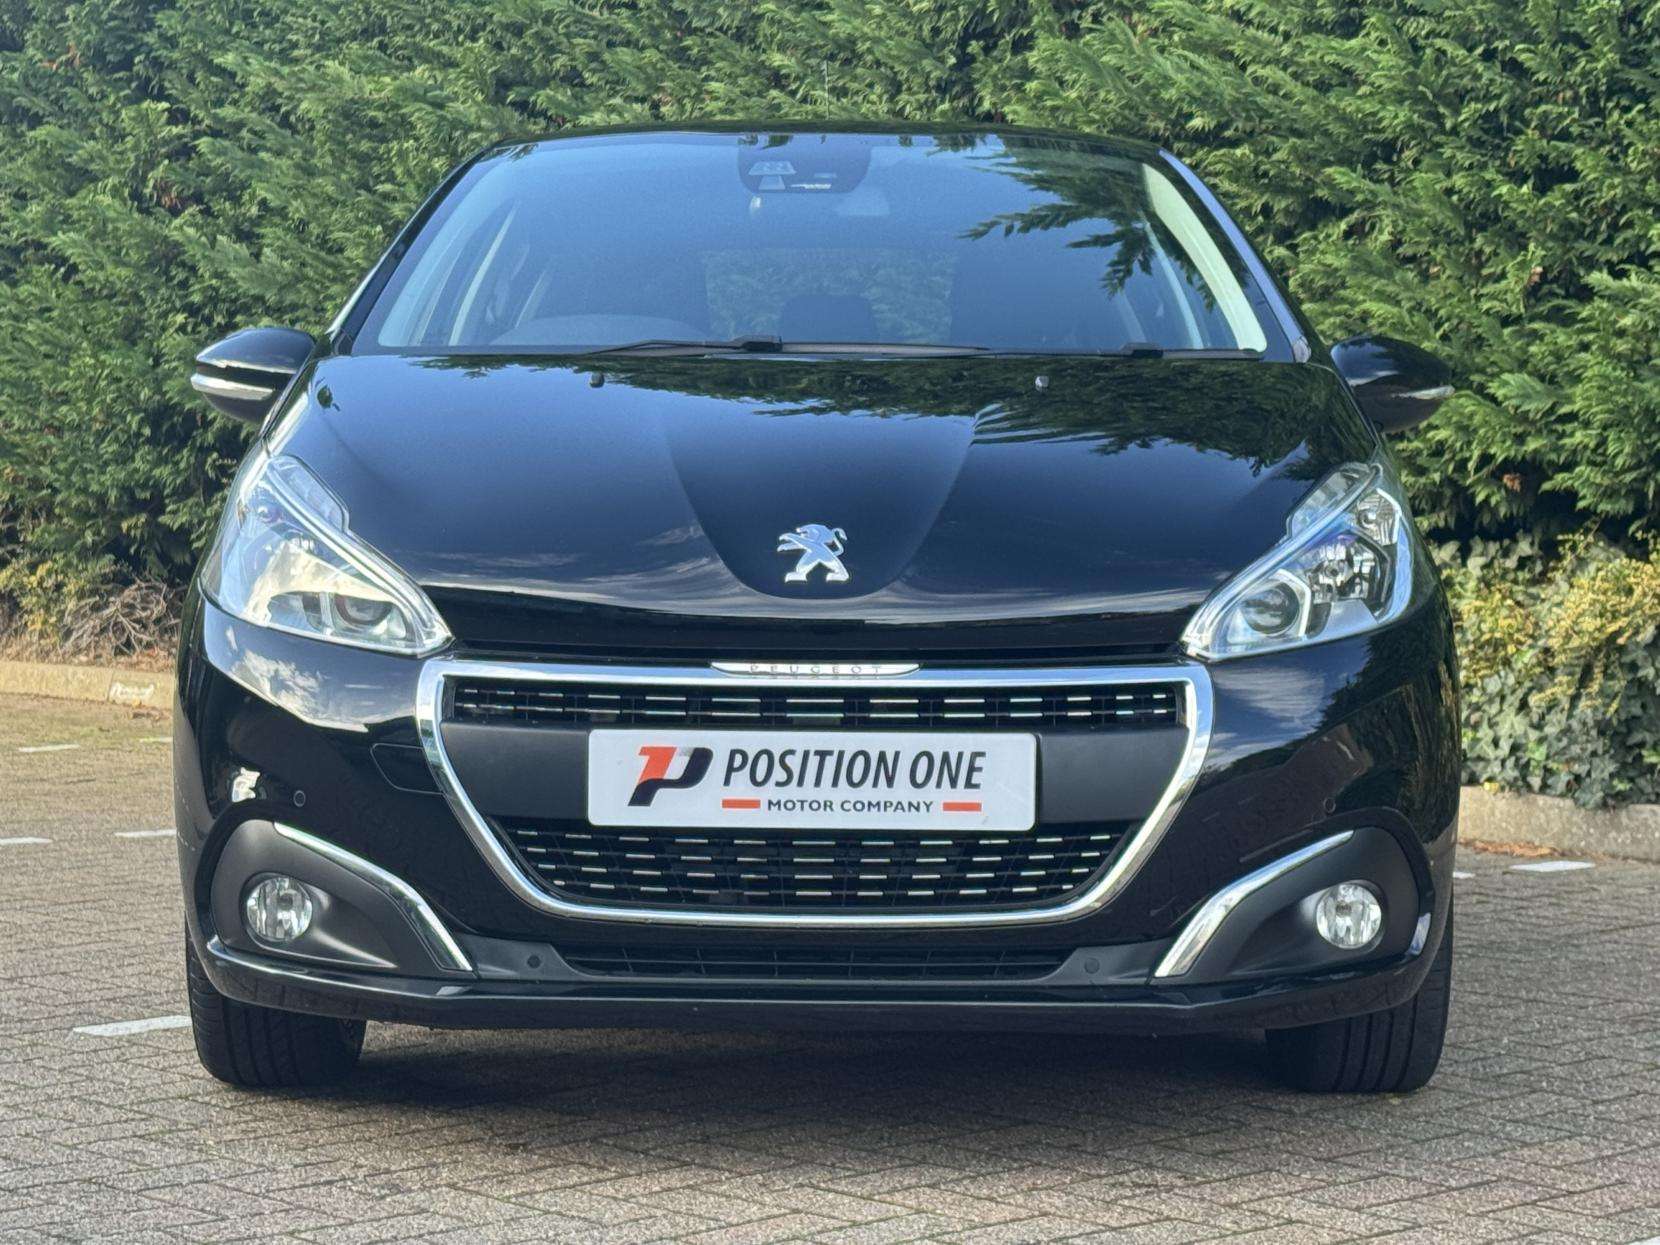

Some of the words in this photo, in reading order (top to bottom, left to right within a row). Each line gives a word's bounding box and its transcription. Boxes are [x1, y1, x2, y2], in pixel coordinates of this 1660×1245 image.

[750, 664, 882, 674] PEUGEOT
[723, 748, 901, 789] POSITION
[909, 750, 987, 790] ONE
[767, 799, 835, 812] MOTOR
[840, 800, 934, 813] COMPANY
